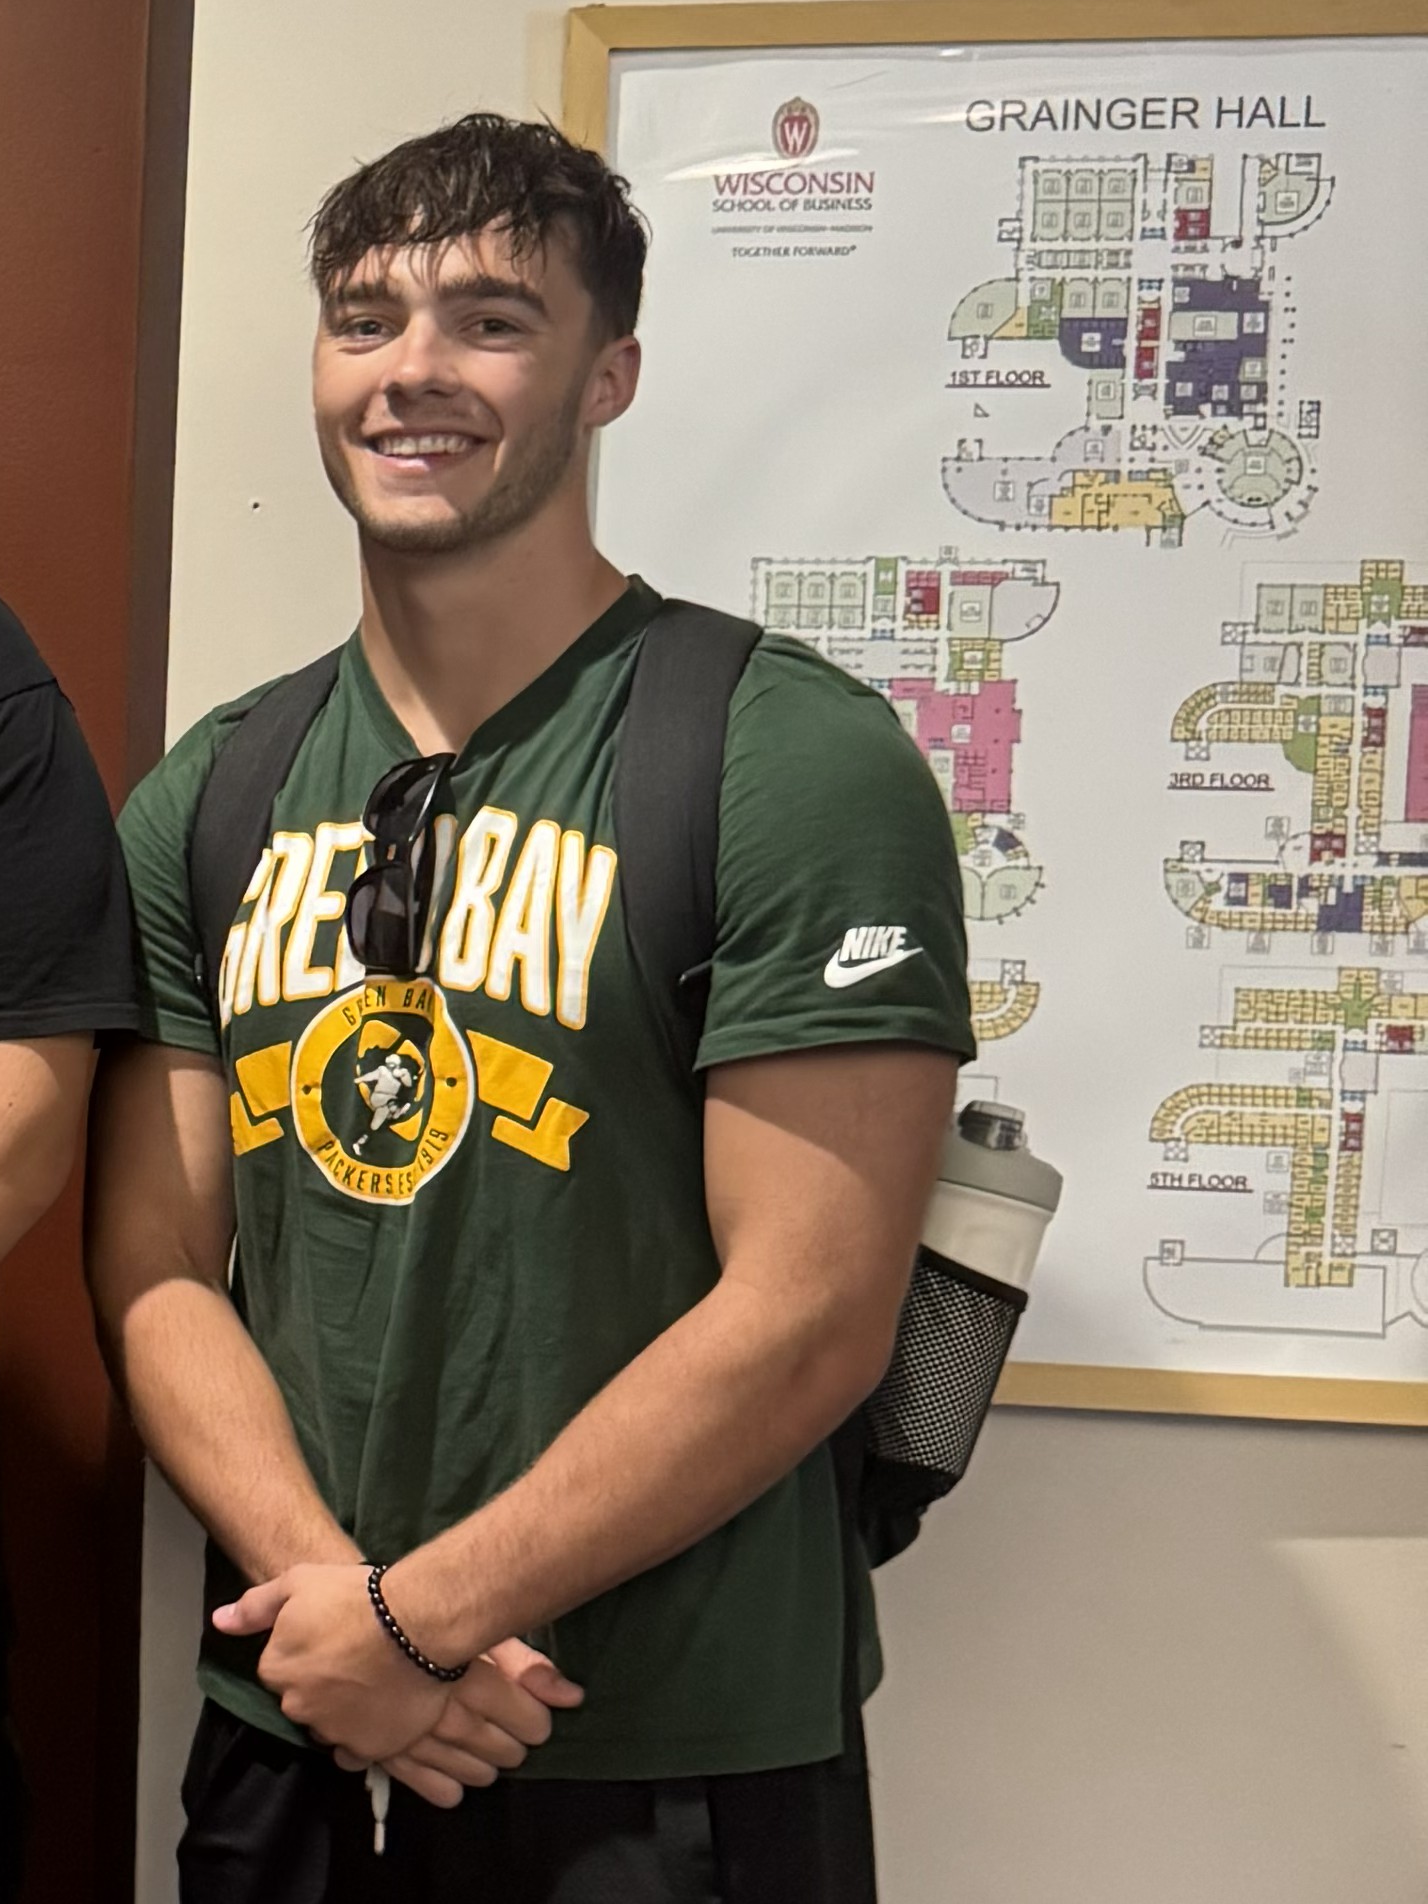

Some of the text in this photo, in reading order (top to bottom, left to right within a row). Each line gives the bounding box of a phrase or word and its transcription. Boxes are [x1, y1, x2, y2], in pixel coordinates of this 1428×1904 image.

[965, 95, 1326, 132] GRAINGER HALL
[713, 171, 875, 196] WISCONSIN
[712, 198, 873, 213] SCHOOL OF BUSINESS
[951, 370, 1045, 386] 1ST FLOOR
[1169, 773, 1270, 788] 3RD FLOOR
[438, 804, 618, 1031] BAY
[839, 925, 907, 962] NIKE
[317, 1140, 393, 1194] PACKERS
[1150, 1172, 1247, 1190] 5TH FLOOR
